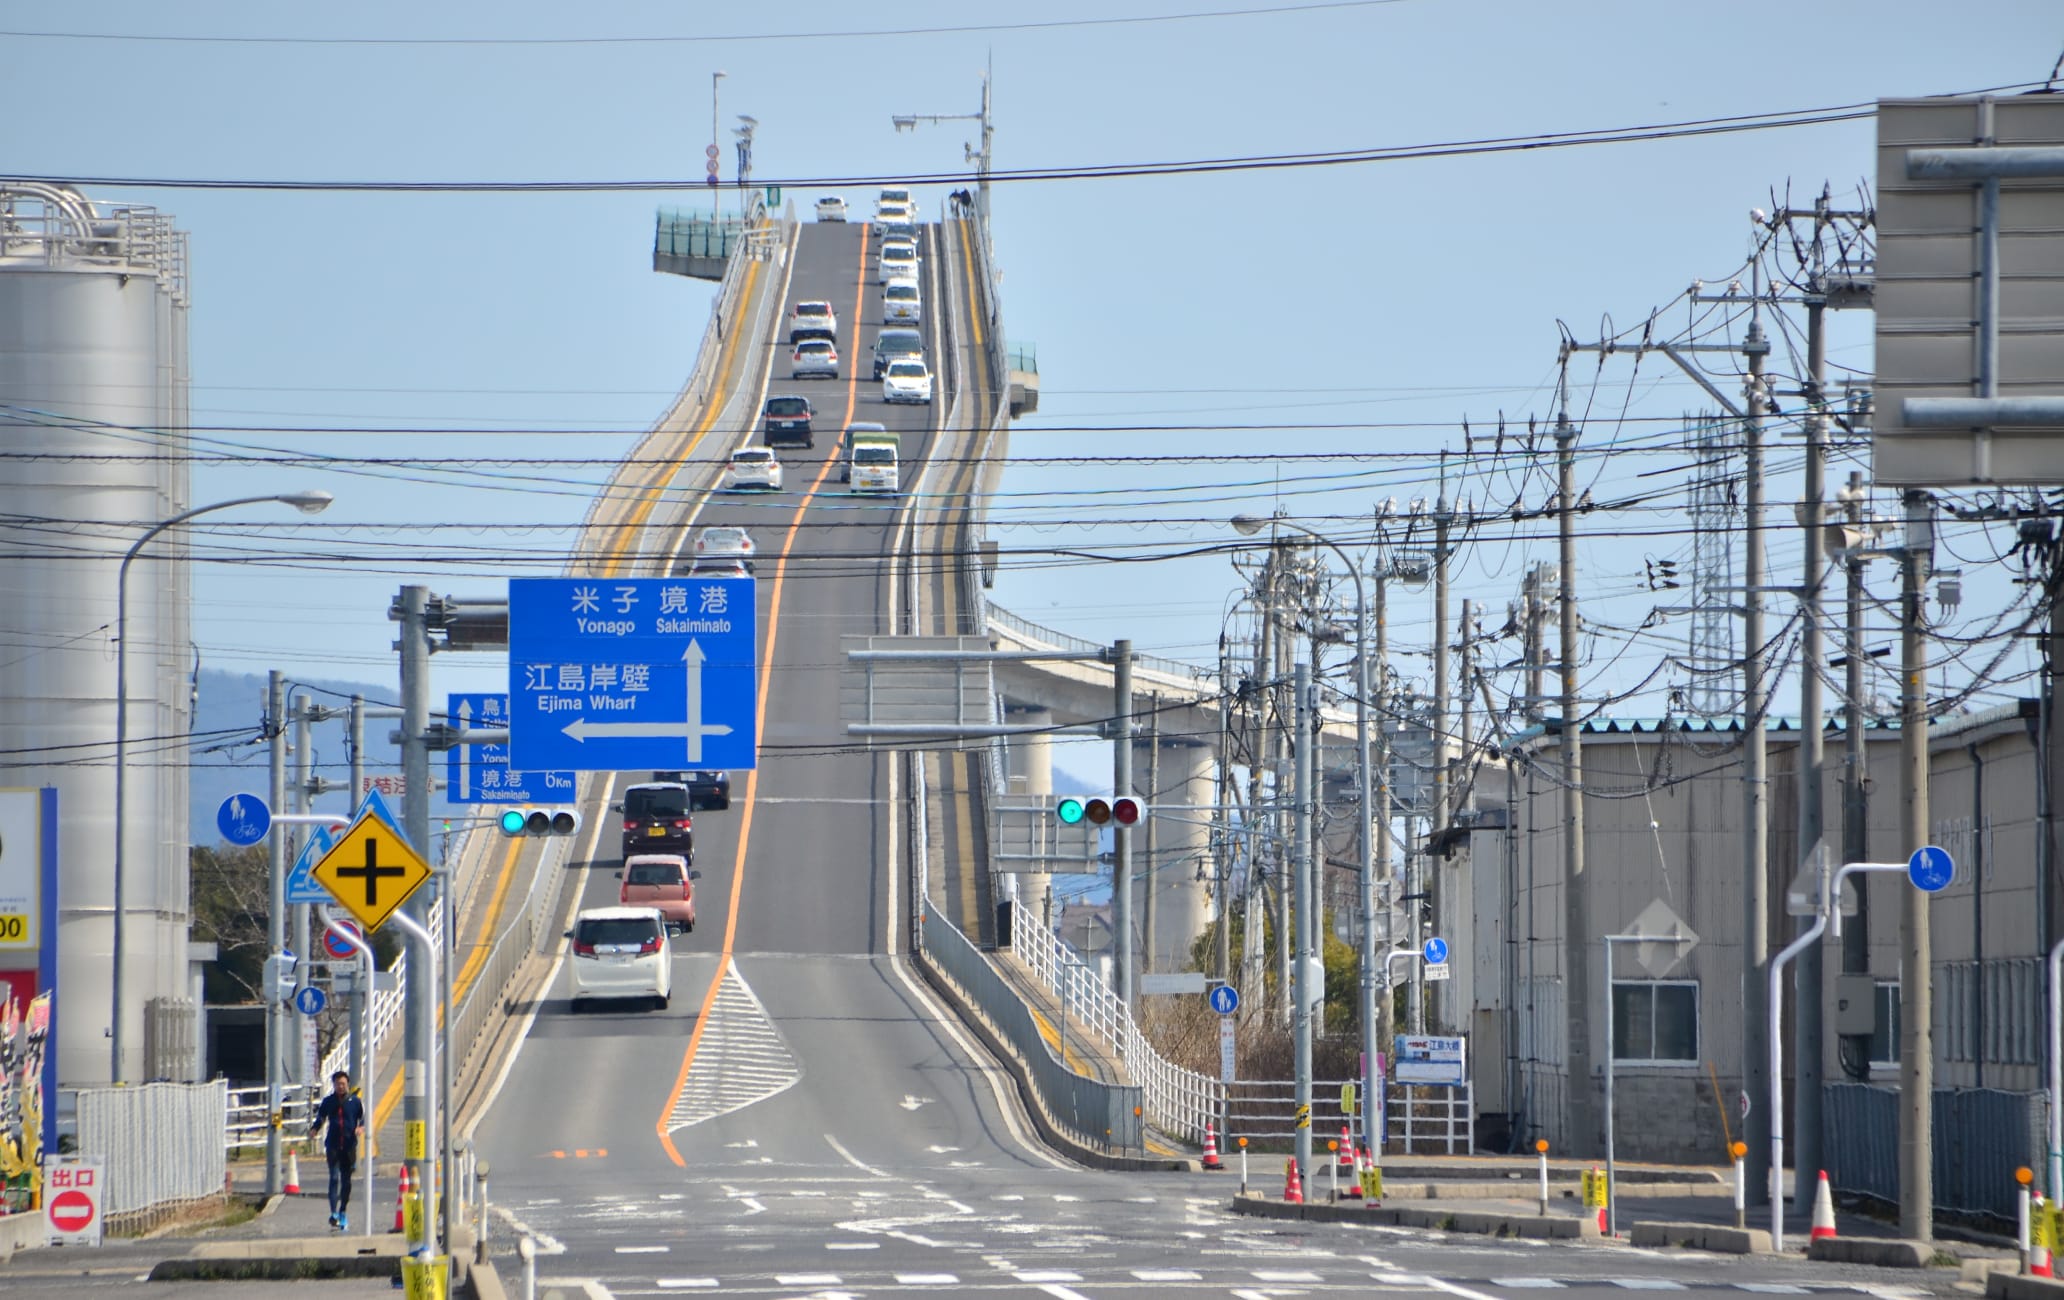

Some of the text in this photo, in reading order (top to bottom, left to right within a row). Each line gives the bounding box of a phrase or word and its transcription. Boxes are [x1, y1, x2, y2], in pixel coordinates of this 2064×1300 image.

[571, 585, 728, 614] 米子 境港
[576, 618, 731, 636] Yonago Sakaiminato
[524, 663, 650, 692] 江島岸壁
[538, 695, 637, 713] Ejima Wharf
[481, 770, 522, 788] 境港
[481, 789, 531, 800] Sakaiminato
[52, 1168, 95, 1187] 出口
